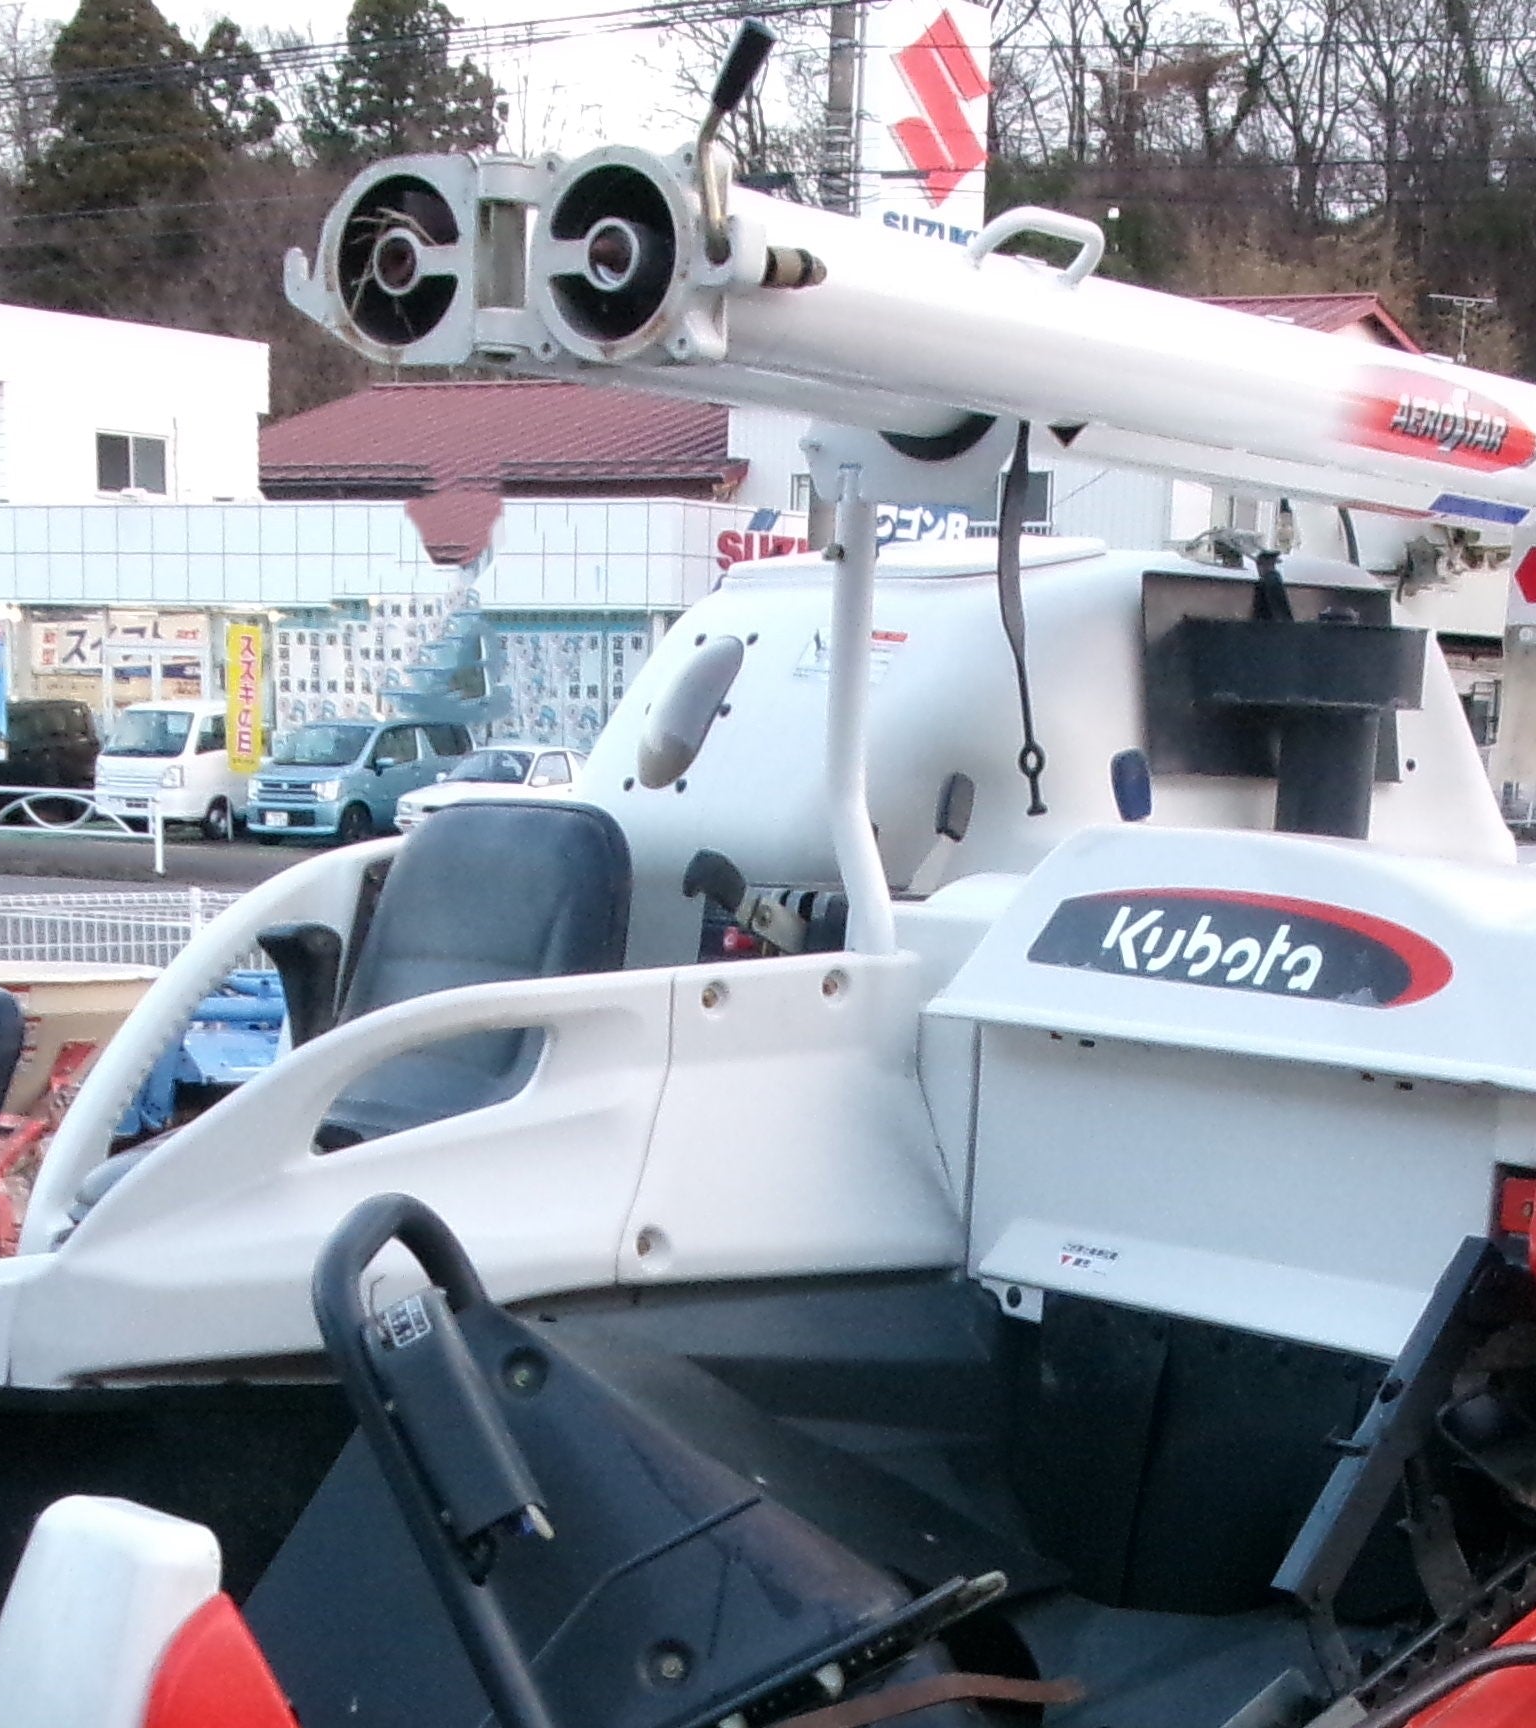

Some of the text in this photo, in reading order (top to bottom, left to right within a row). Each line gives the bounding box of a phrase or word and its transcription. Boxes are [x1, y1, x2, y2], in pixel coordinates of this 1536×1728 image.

[1390, 387, 1508, 456] AEROSTAR
[237, 635, 256, 753] スズキの日
[1101, 906, 1324, 992] Kubota
